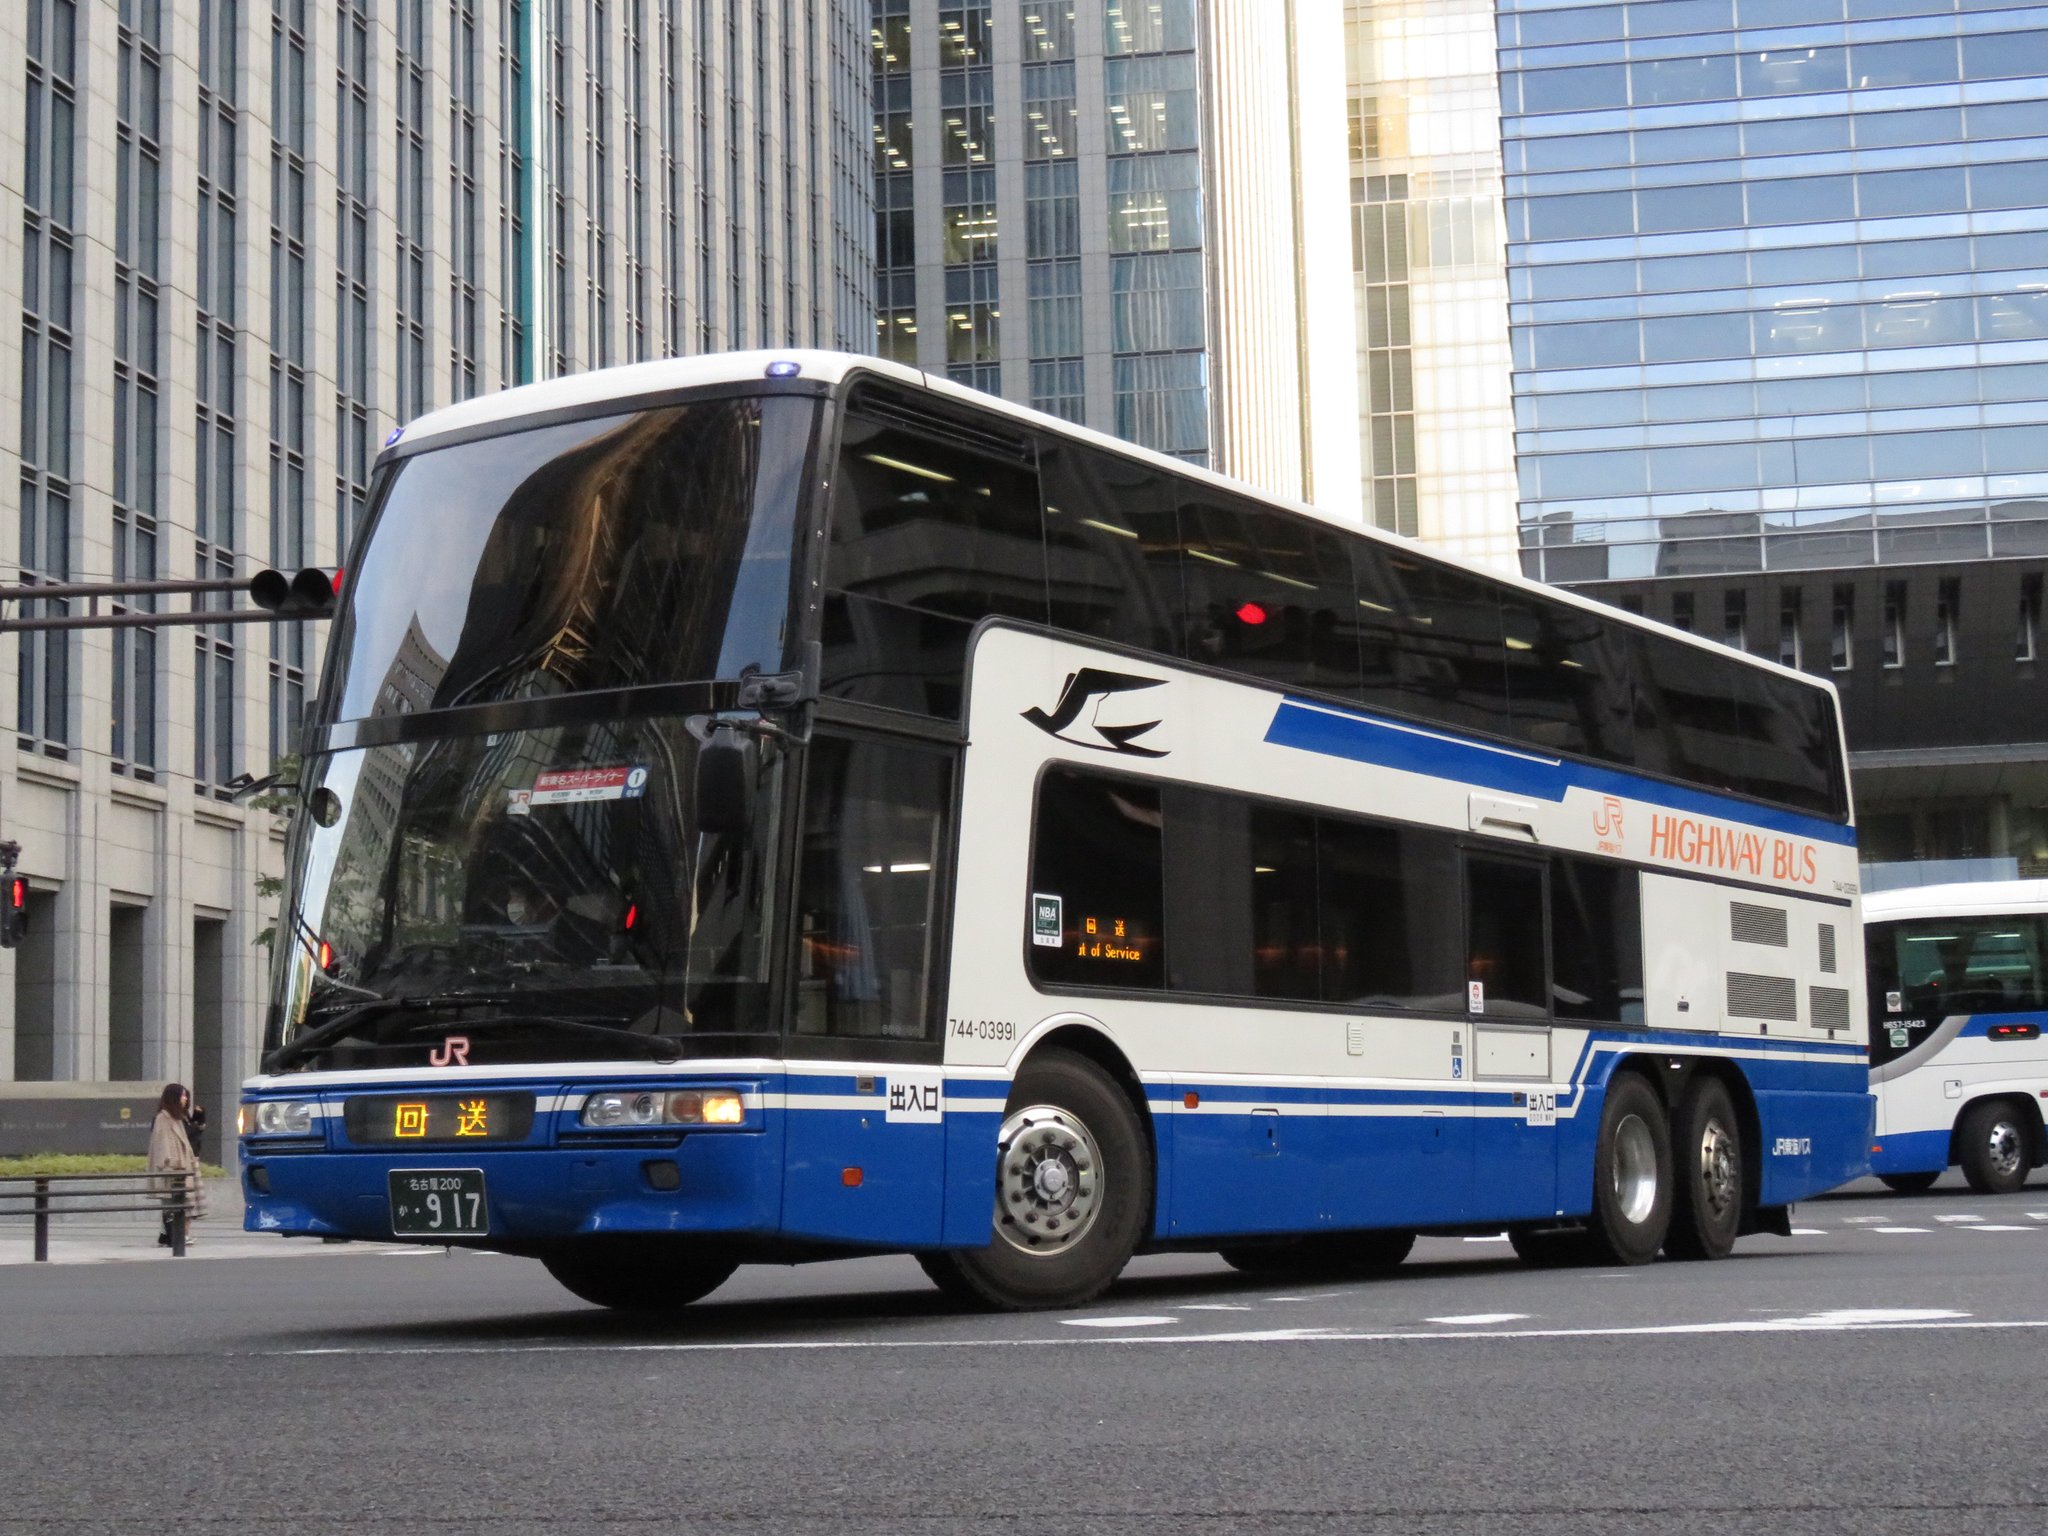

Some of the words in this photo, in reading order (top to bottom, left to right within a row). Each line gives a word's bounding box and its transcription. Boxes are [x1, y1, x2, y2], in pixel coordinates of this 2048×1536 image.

[1593, 796, 1624, 839] JR
[1650, 813, 1767, 876] HIGHWAY
[1772, 839, 1817, 885] BUS
[1039, 906, 1057, 919] NBA
[1090, 942, 1101, 957] of
[1105, 943, 1140, 961] Service
[949, 1018, 1016, 1041] 744-03991
[430, 1036, 470, 1067] JR
[890, 1084, 938, 1112] 出入口
[1529, 1093, 1553, 1111] 出入口
